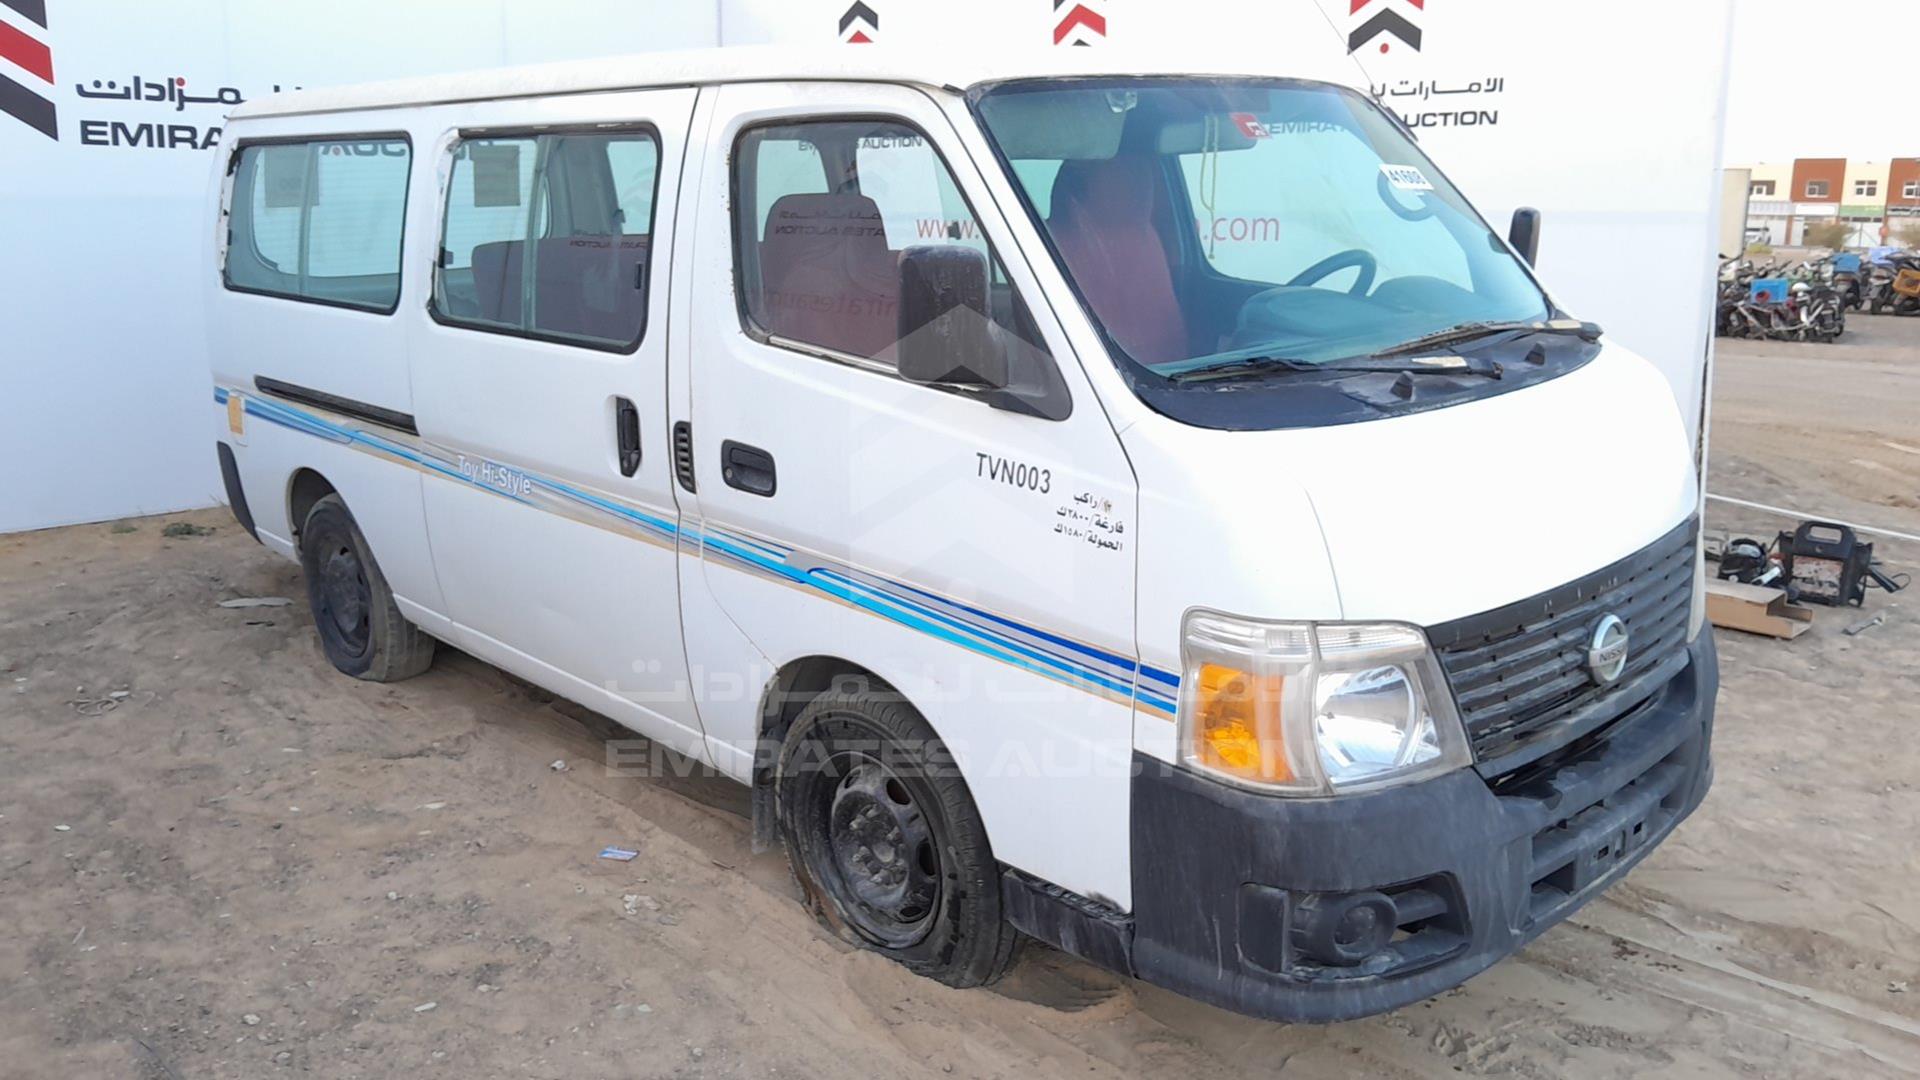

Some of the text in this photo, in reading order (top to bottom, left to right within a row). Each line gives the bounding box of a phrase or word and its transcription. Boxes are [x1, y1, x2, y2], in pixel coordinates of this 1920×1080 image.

[79, 119, 223, 150] EMIRA
[1403, 110, 1498, 127] UCTION
[457, 454, 532, 495] Toy Hi-Style
[976, 452, 1051, 493] TVN003
